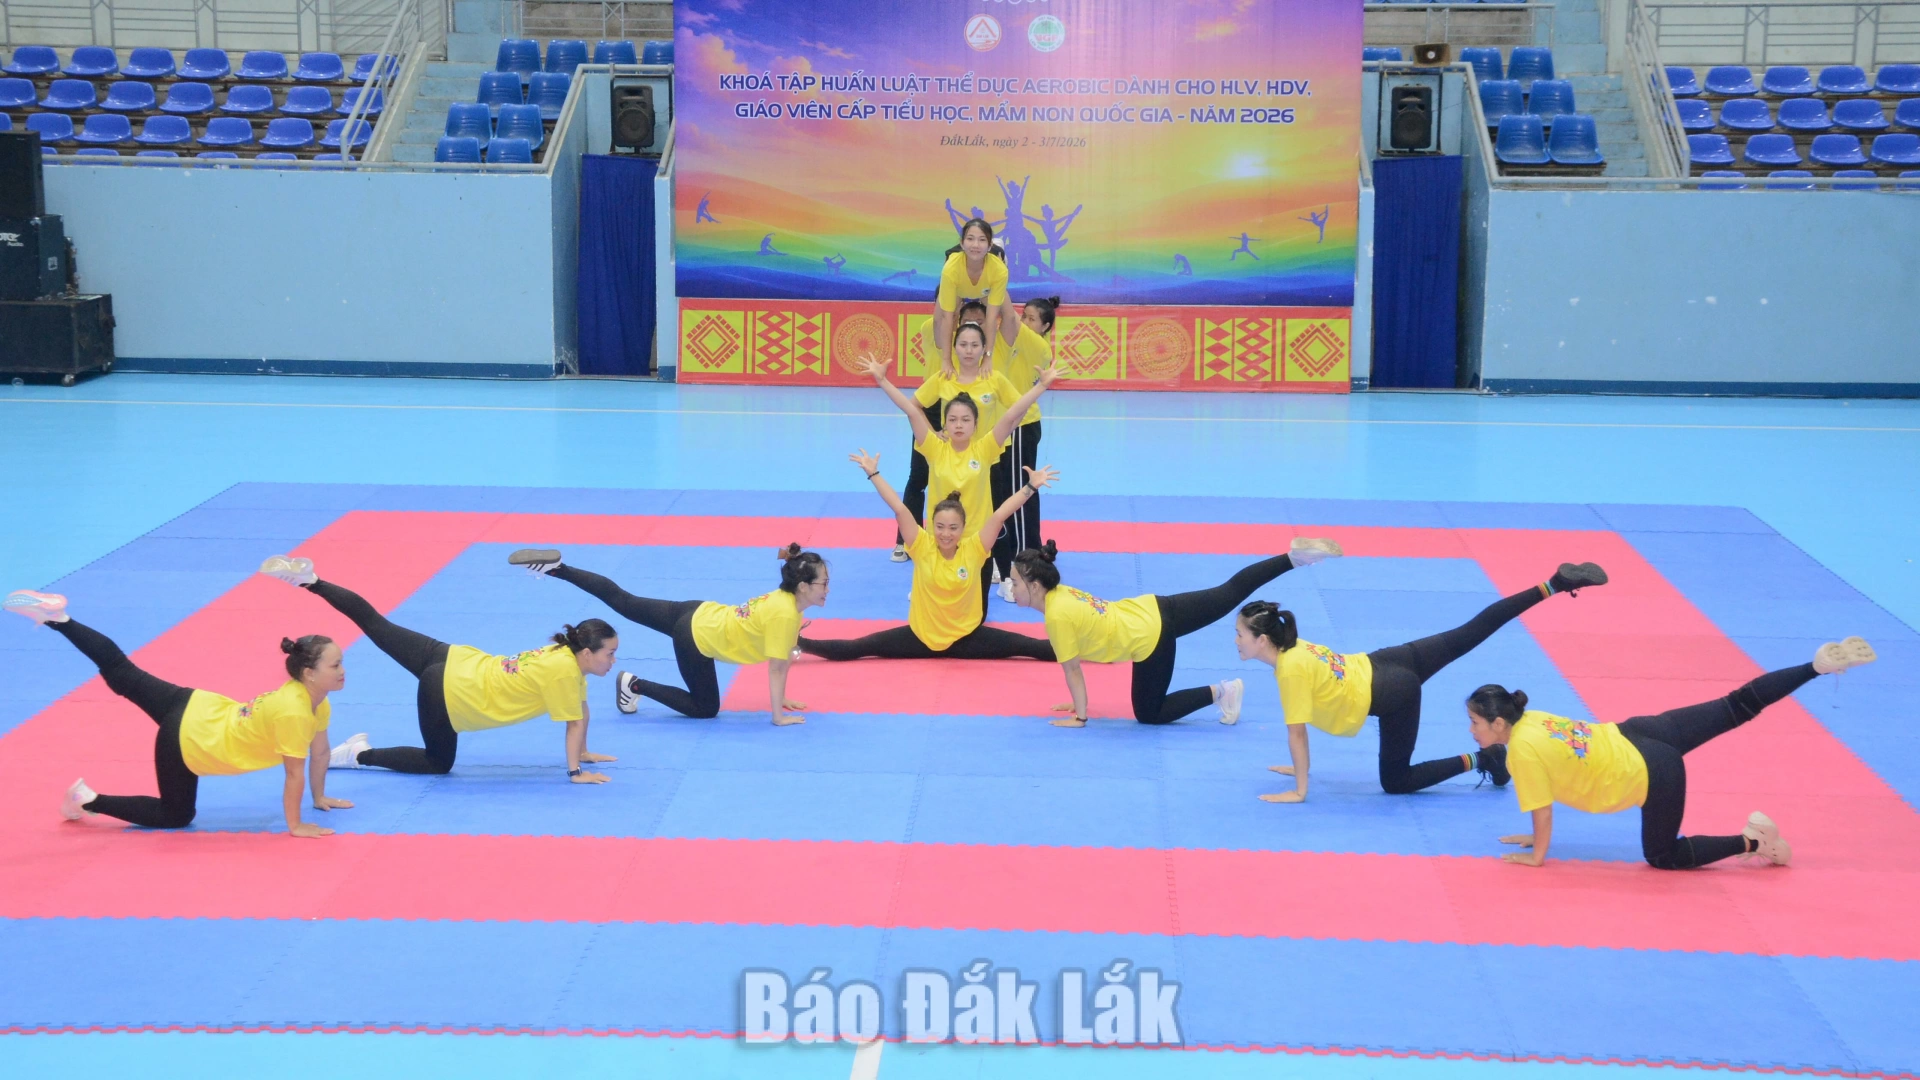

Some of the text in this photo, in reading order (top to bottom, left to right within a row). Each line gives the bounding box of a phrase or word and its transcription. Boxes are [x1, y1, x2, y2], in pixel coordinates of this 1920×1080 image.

[719, 70, 1311, 97] KHOÁ TẬP HUẤN LUẬT THỂ DỤC AEROBIC DÀNH CHO HLV, HDV,
[735, 98, 782, 118] GIÁO
[786, 99, 832, 119] VIÊN
[837, 98, 876, 119] CẤP
[881, 99, 924, 121] TIỂU
[930, 105, 973, 125] HỌC,
[1032, 107, 1075, 122] NON
[1080, 101, 1136, 123] QUỐC
[1140, 107, 1173, 123] GIA
[1190, 104, 1235, 123] NĂM
[1240, 107, 1294, 124] 2026
[992, 138, 1019, 149] ngày
[1022, 137, 1029, 147] 2
[1039, 137, 1087, 148] 3/7/2026
